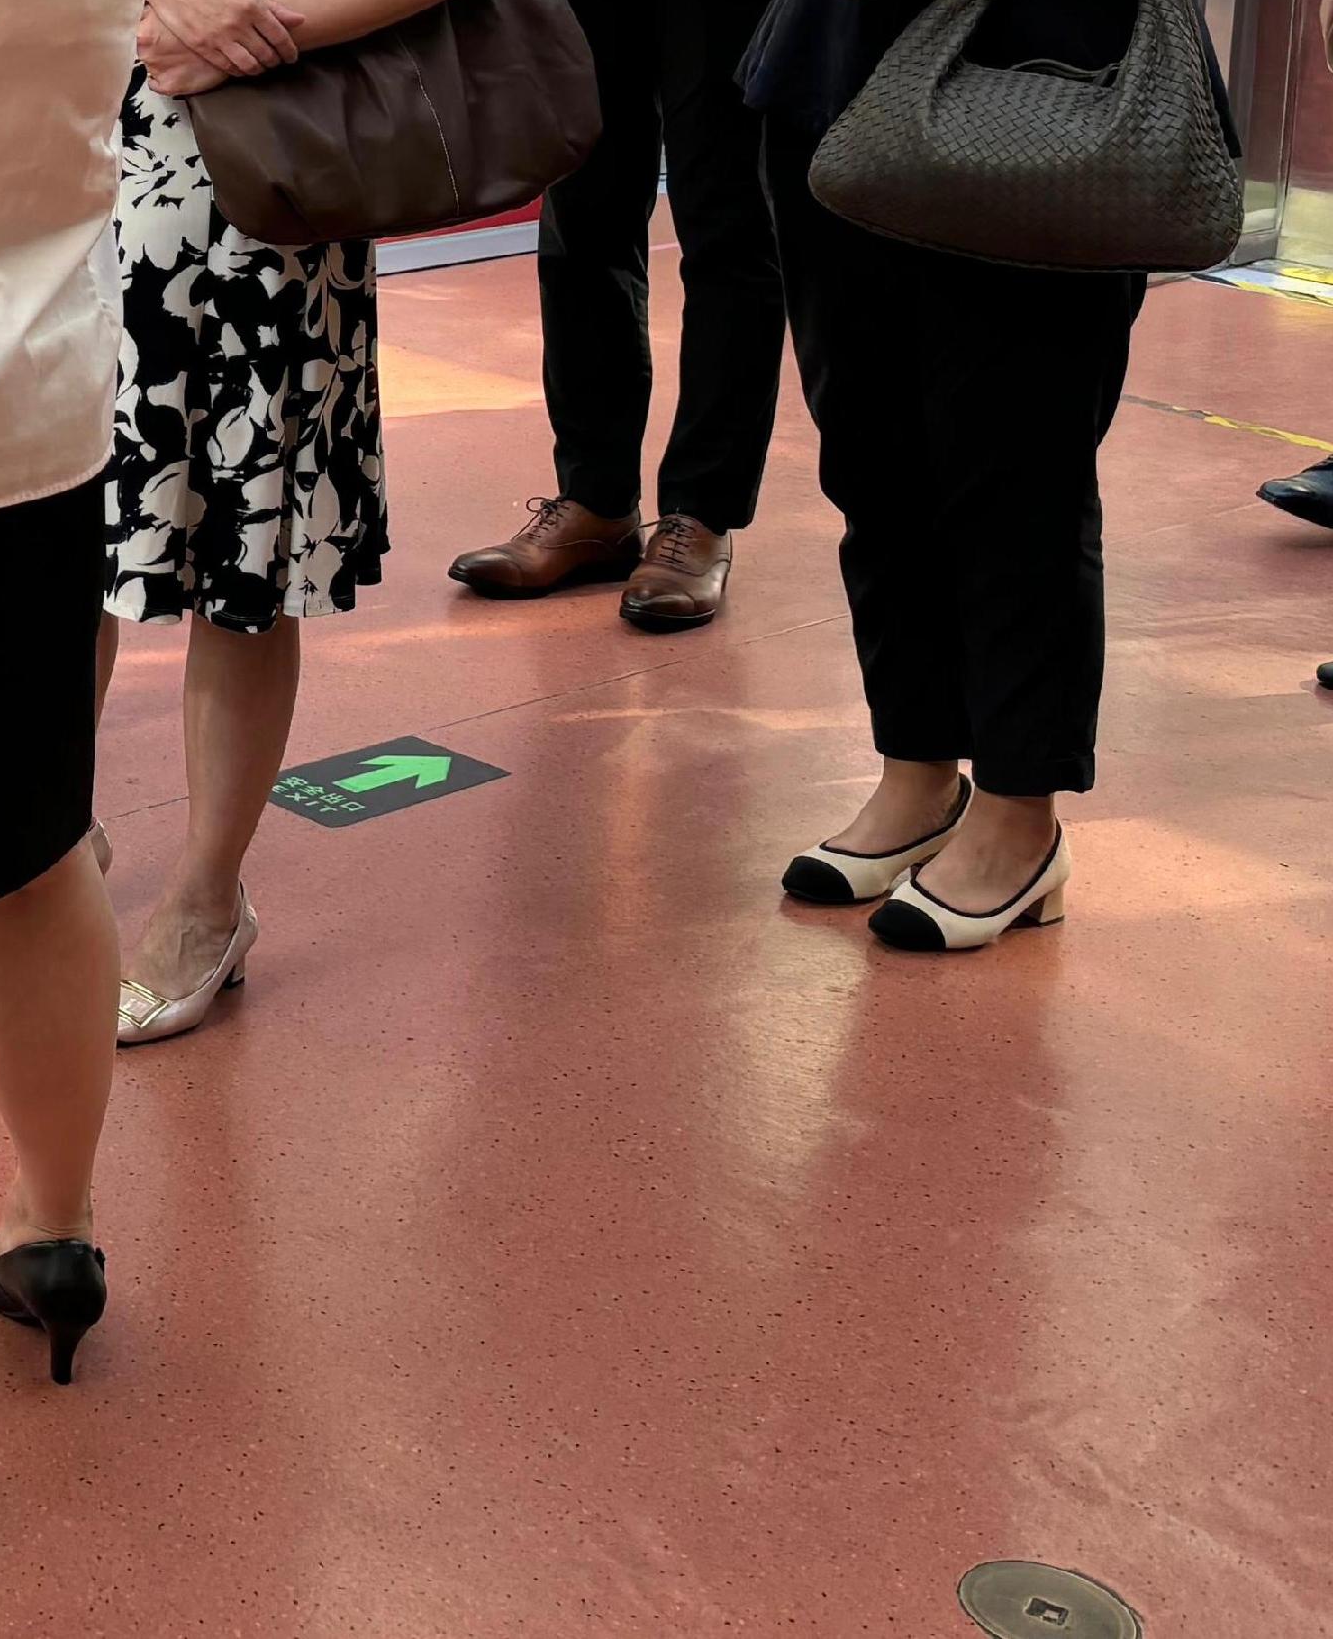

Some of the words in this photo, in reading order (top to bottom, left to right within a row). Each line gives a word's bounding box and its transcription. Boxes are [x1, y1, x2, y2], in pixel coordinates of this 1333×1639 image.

[271, 784, 339, 813] EXIT
[279, 776, 366, 812] 安全出口
